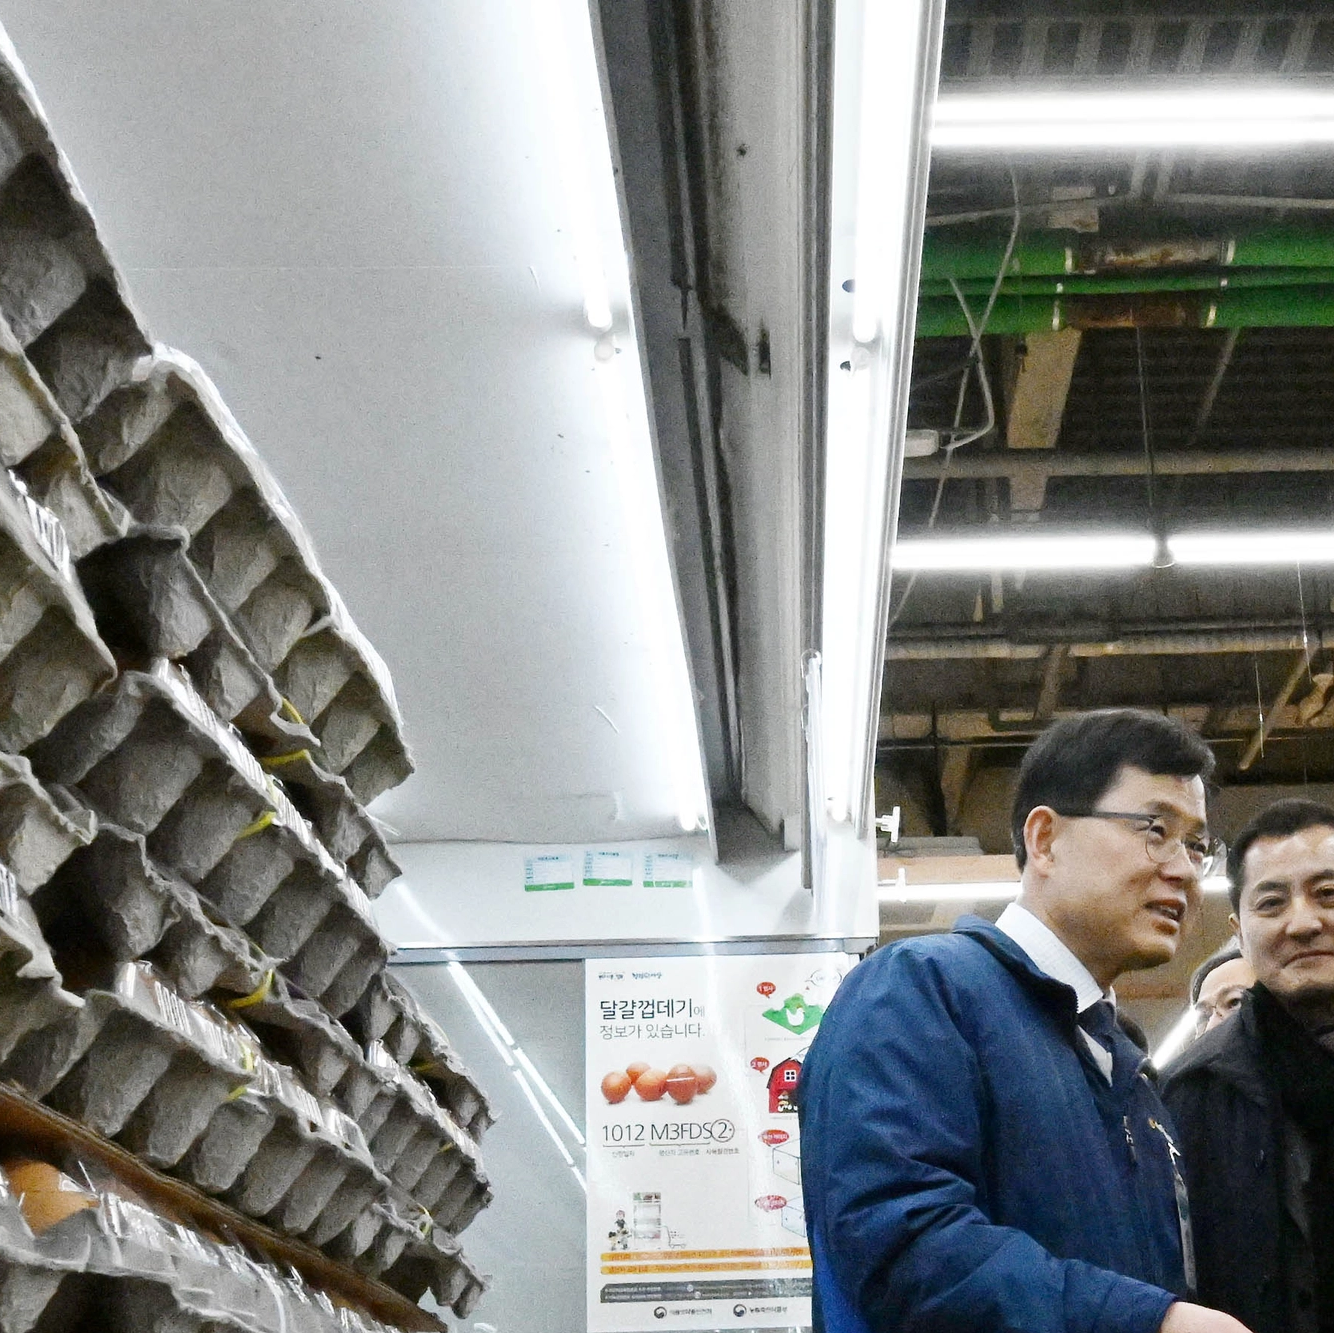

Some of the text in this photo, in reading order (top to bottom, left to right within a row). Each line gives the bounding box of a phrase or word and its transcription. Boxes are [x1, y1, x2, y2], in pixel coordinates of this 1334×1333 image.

[600, 998, 705, 1020] 달걀껍데기에
[599, 1022, 706, 1040] 정보가 있습니다.
[602, 1123, 645, 1142] 1012
